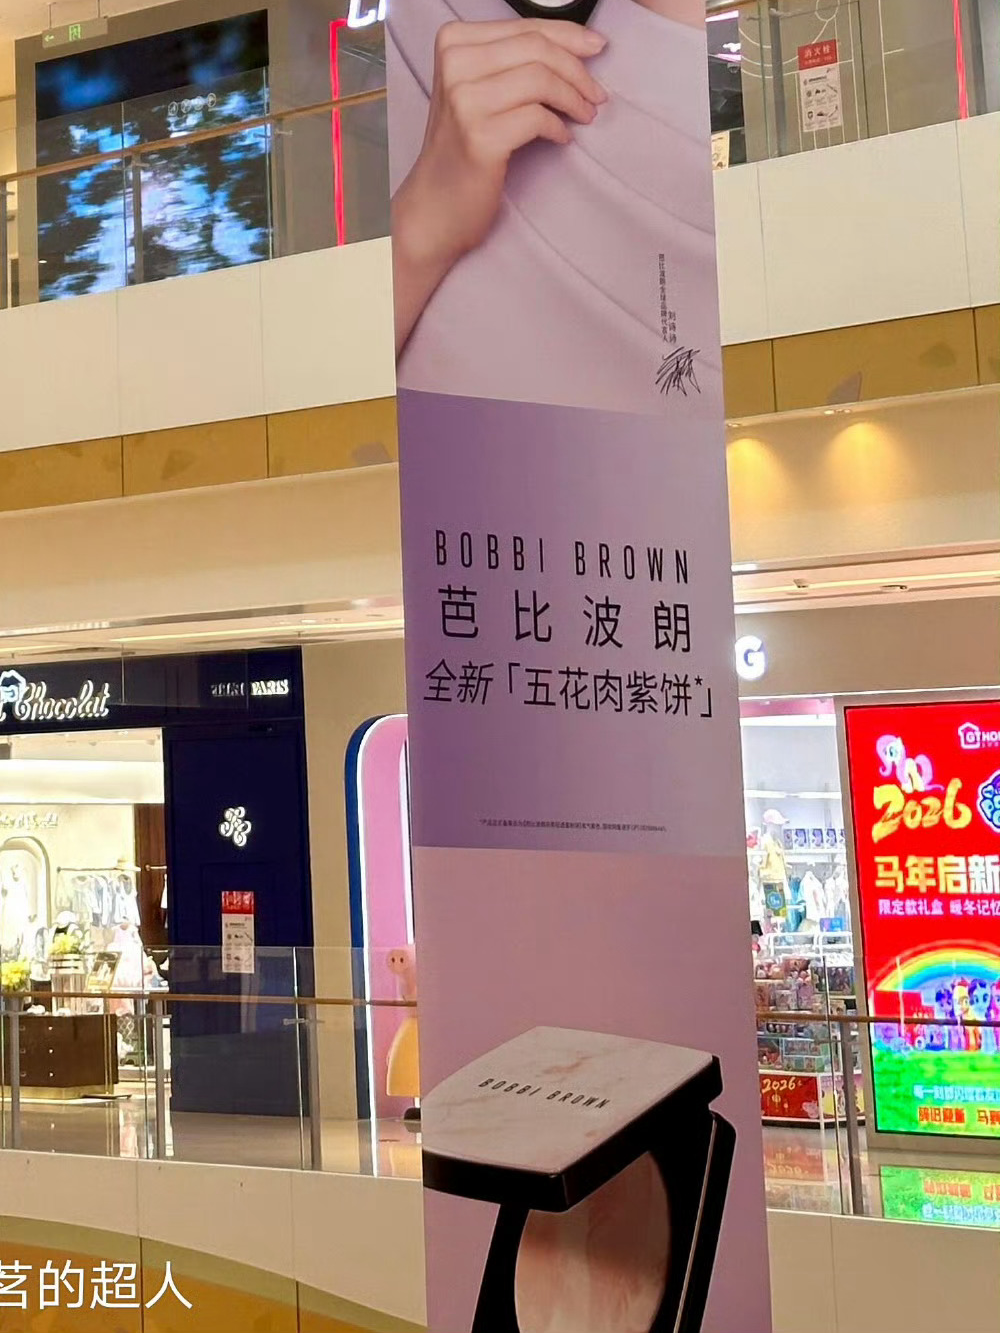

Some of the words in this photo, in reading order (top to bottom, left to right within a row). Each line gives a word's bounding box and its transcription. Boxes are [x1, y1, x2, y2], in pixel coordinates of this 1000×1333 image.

[435, 529, 544, 573] BOBBI
[574, 541, 689, 584] BROWN
[438, 584, 692, 654] 芭比波朗
[250, 678, 289, 695] PARIS
[872, 778, 973, 844] 2026
[874, 855, 1000, 893] 马年启新
[879, 898, 945, 915] 限定款礼盒
[478, 1078, 542, 1096] BOBBI
[546, 1090, 611, 1109] BROWN
[761, 1077, 796, 1093] 2026
